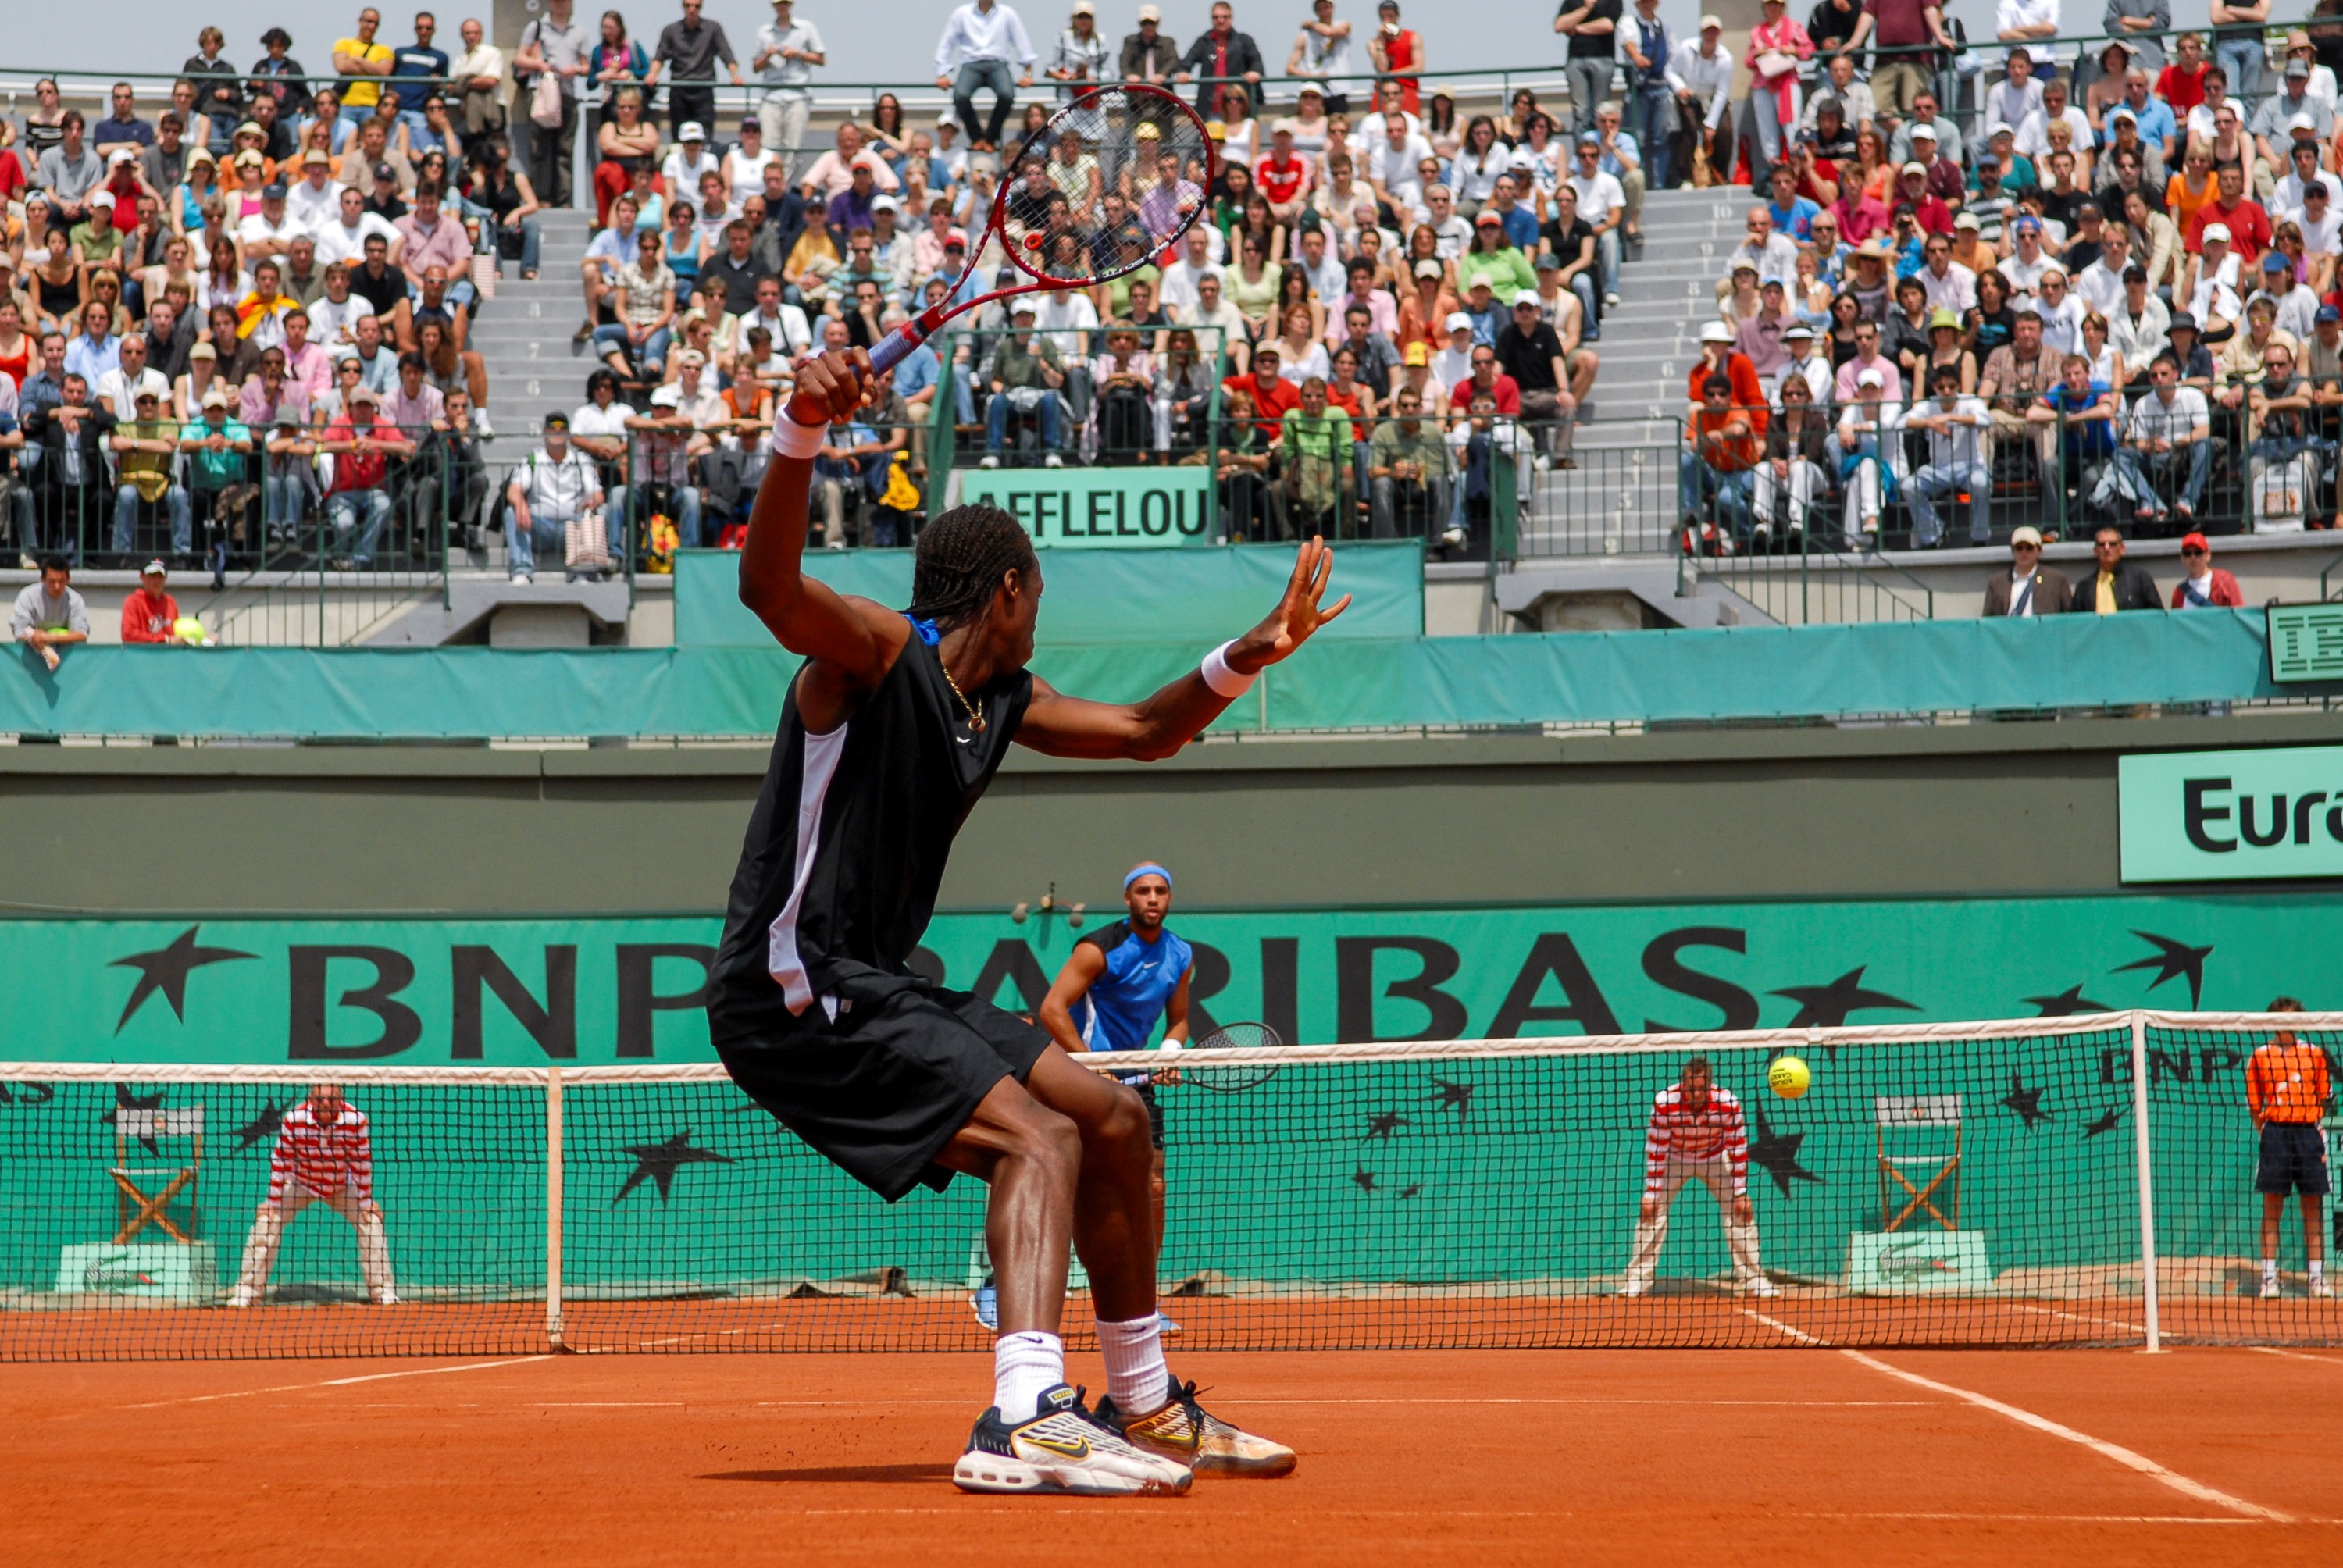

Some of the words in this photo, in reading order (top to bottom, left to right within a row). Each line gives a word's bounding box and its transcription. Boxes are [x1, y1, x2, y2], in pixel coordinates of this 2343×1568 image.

[287, 943, 717, 1060] BNP
[904, 926, 1760, 1046] ARIBAS
[2101, 1047, 2241, 1083] BNP
